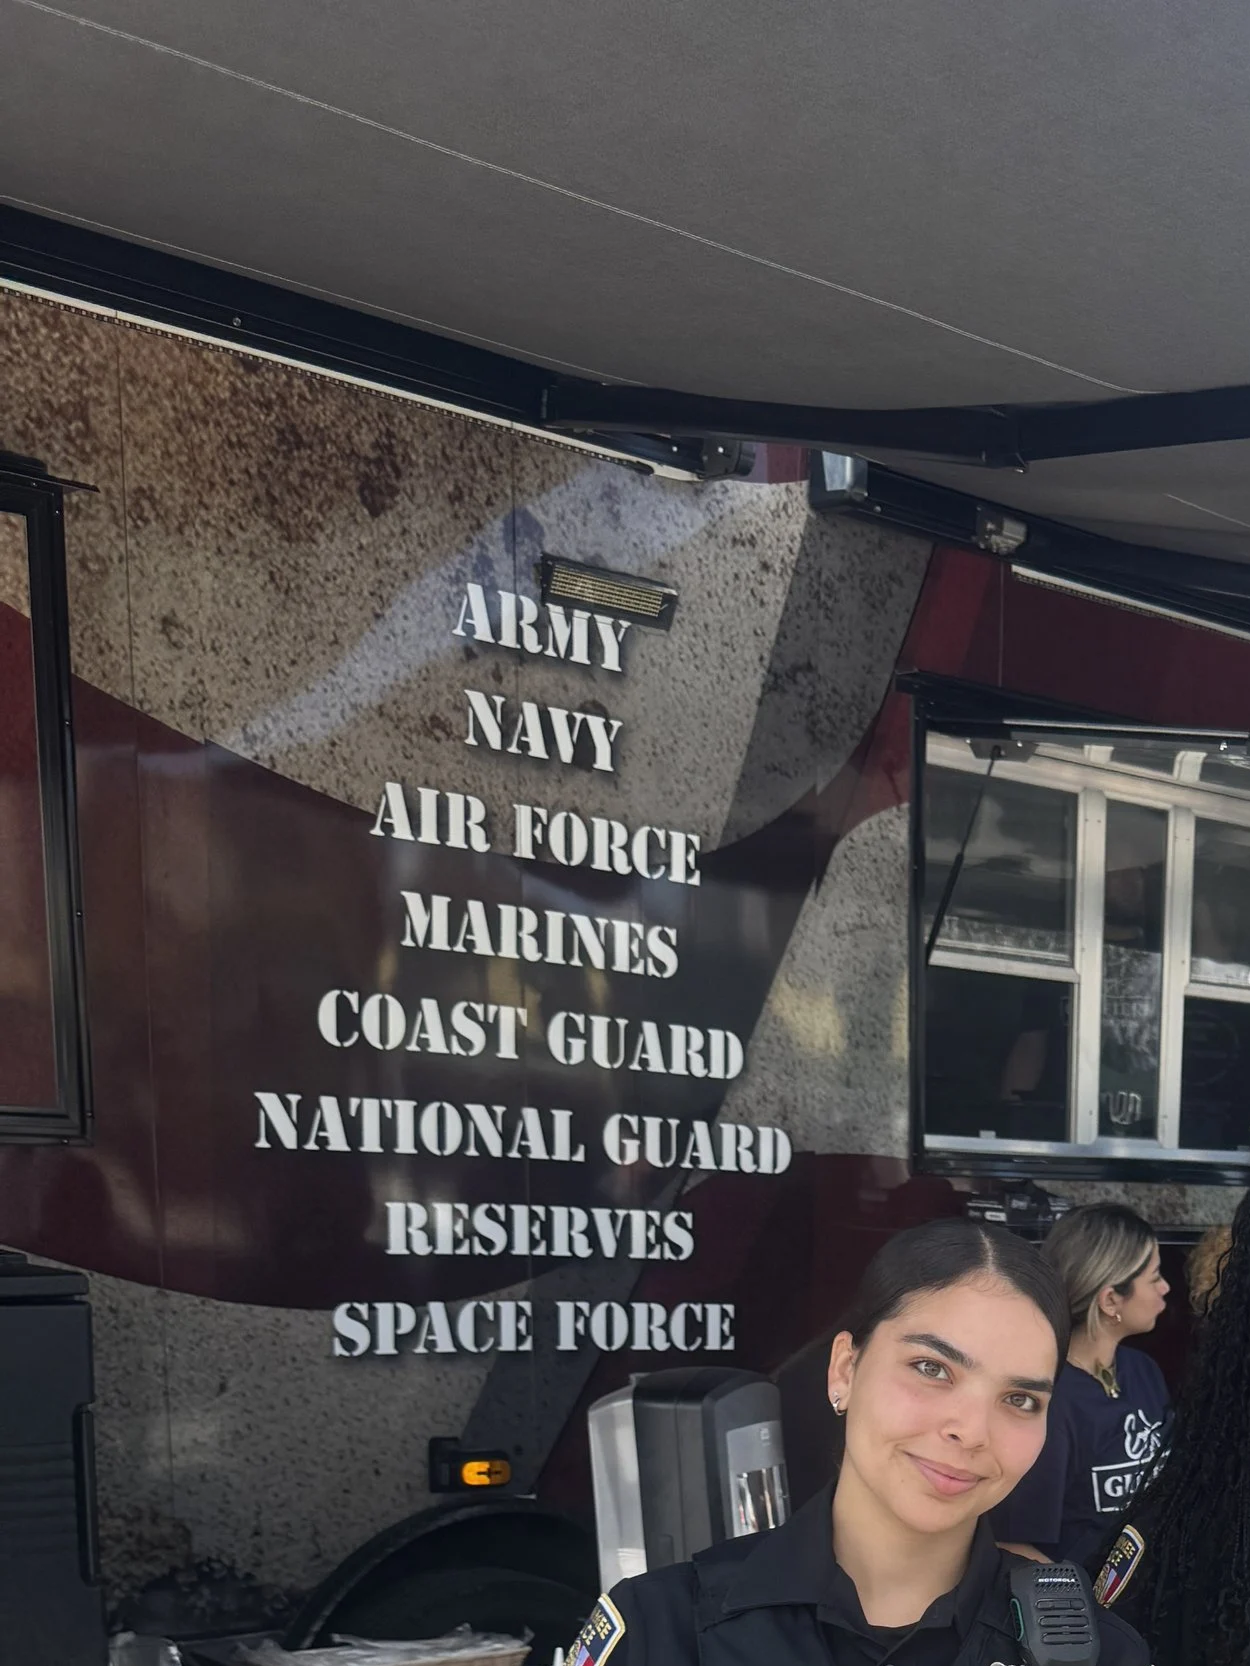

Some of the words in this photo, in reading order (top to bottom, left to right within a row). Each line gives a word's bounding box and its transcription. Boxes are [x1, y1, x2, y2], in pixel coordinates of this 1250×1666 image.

[453, 582, 631, 672] ARMY
[464, 689, 622, 772] NAVY
[370, 781, 491, 854] AIR
[511, 803, 702, 887] FORCE
[400, 892, 679, 978] MARINES
[317, 989, 528, 1061] COAST
[547, 1010, 746, 1081] GUARD
[254, 1092, 585, 1163] NATIONAL
[603, 1115, 793, 1175] GUARD
[385, 1202, 695, 1263] RESERVES
[332, 1301, 533, 1357] SPACE
[555, 1301, 736, 1353] FORCE
